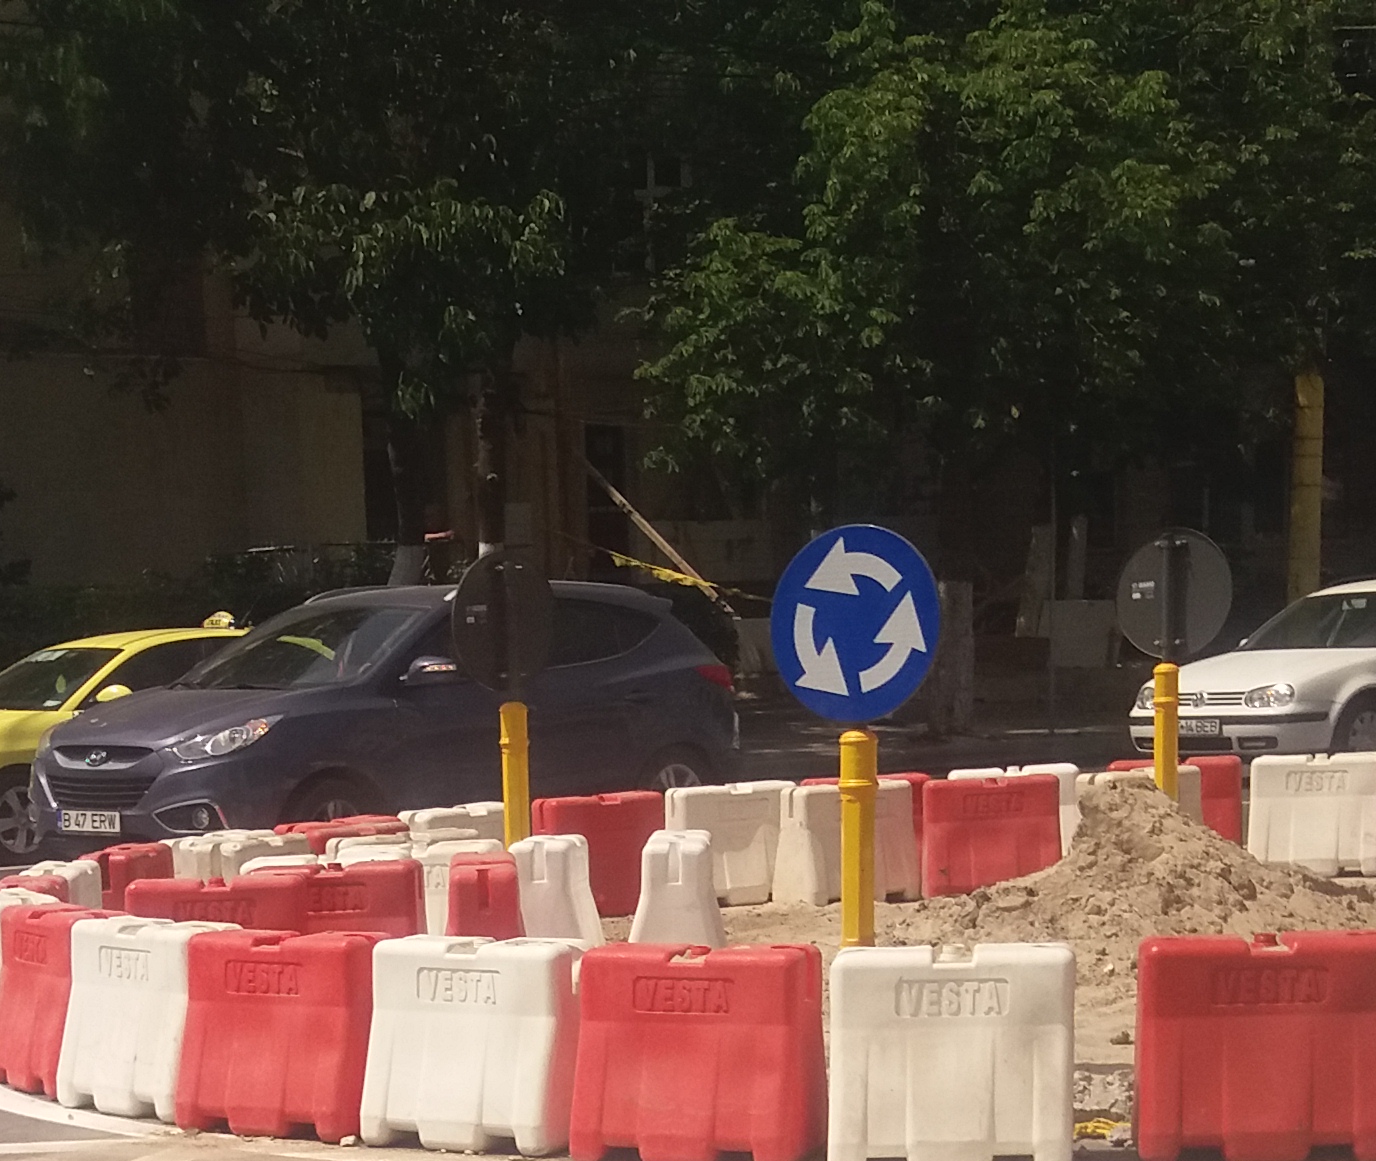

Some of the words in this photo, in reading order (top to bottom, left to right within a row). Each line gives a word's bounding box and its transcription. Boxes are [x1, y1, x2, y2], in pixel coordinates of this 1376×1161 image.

[1292, 772, 1351, 792] VESTA
[63, 812, 71, 828] B
[75, 813, 87, 828] 47
[91, 813, 116, 830] ERW
[105, 949, 149, 981] VESTA
[228, 962, 299, 995] VESTA
[427, 971, 497, 1005] VESTA
[636, 980, 730, 1013] VESTA
[900, 981, 1002, 1017] VESTA
[1218, 970, 1322, 1003] VESTA
